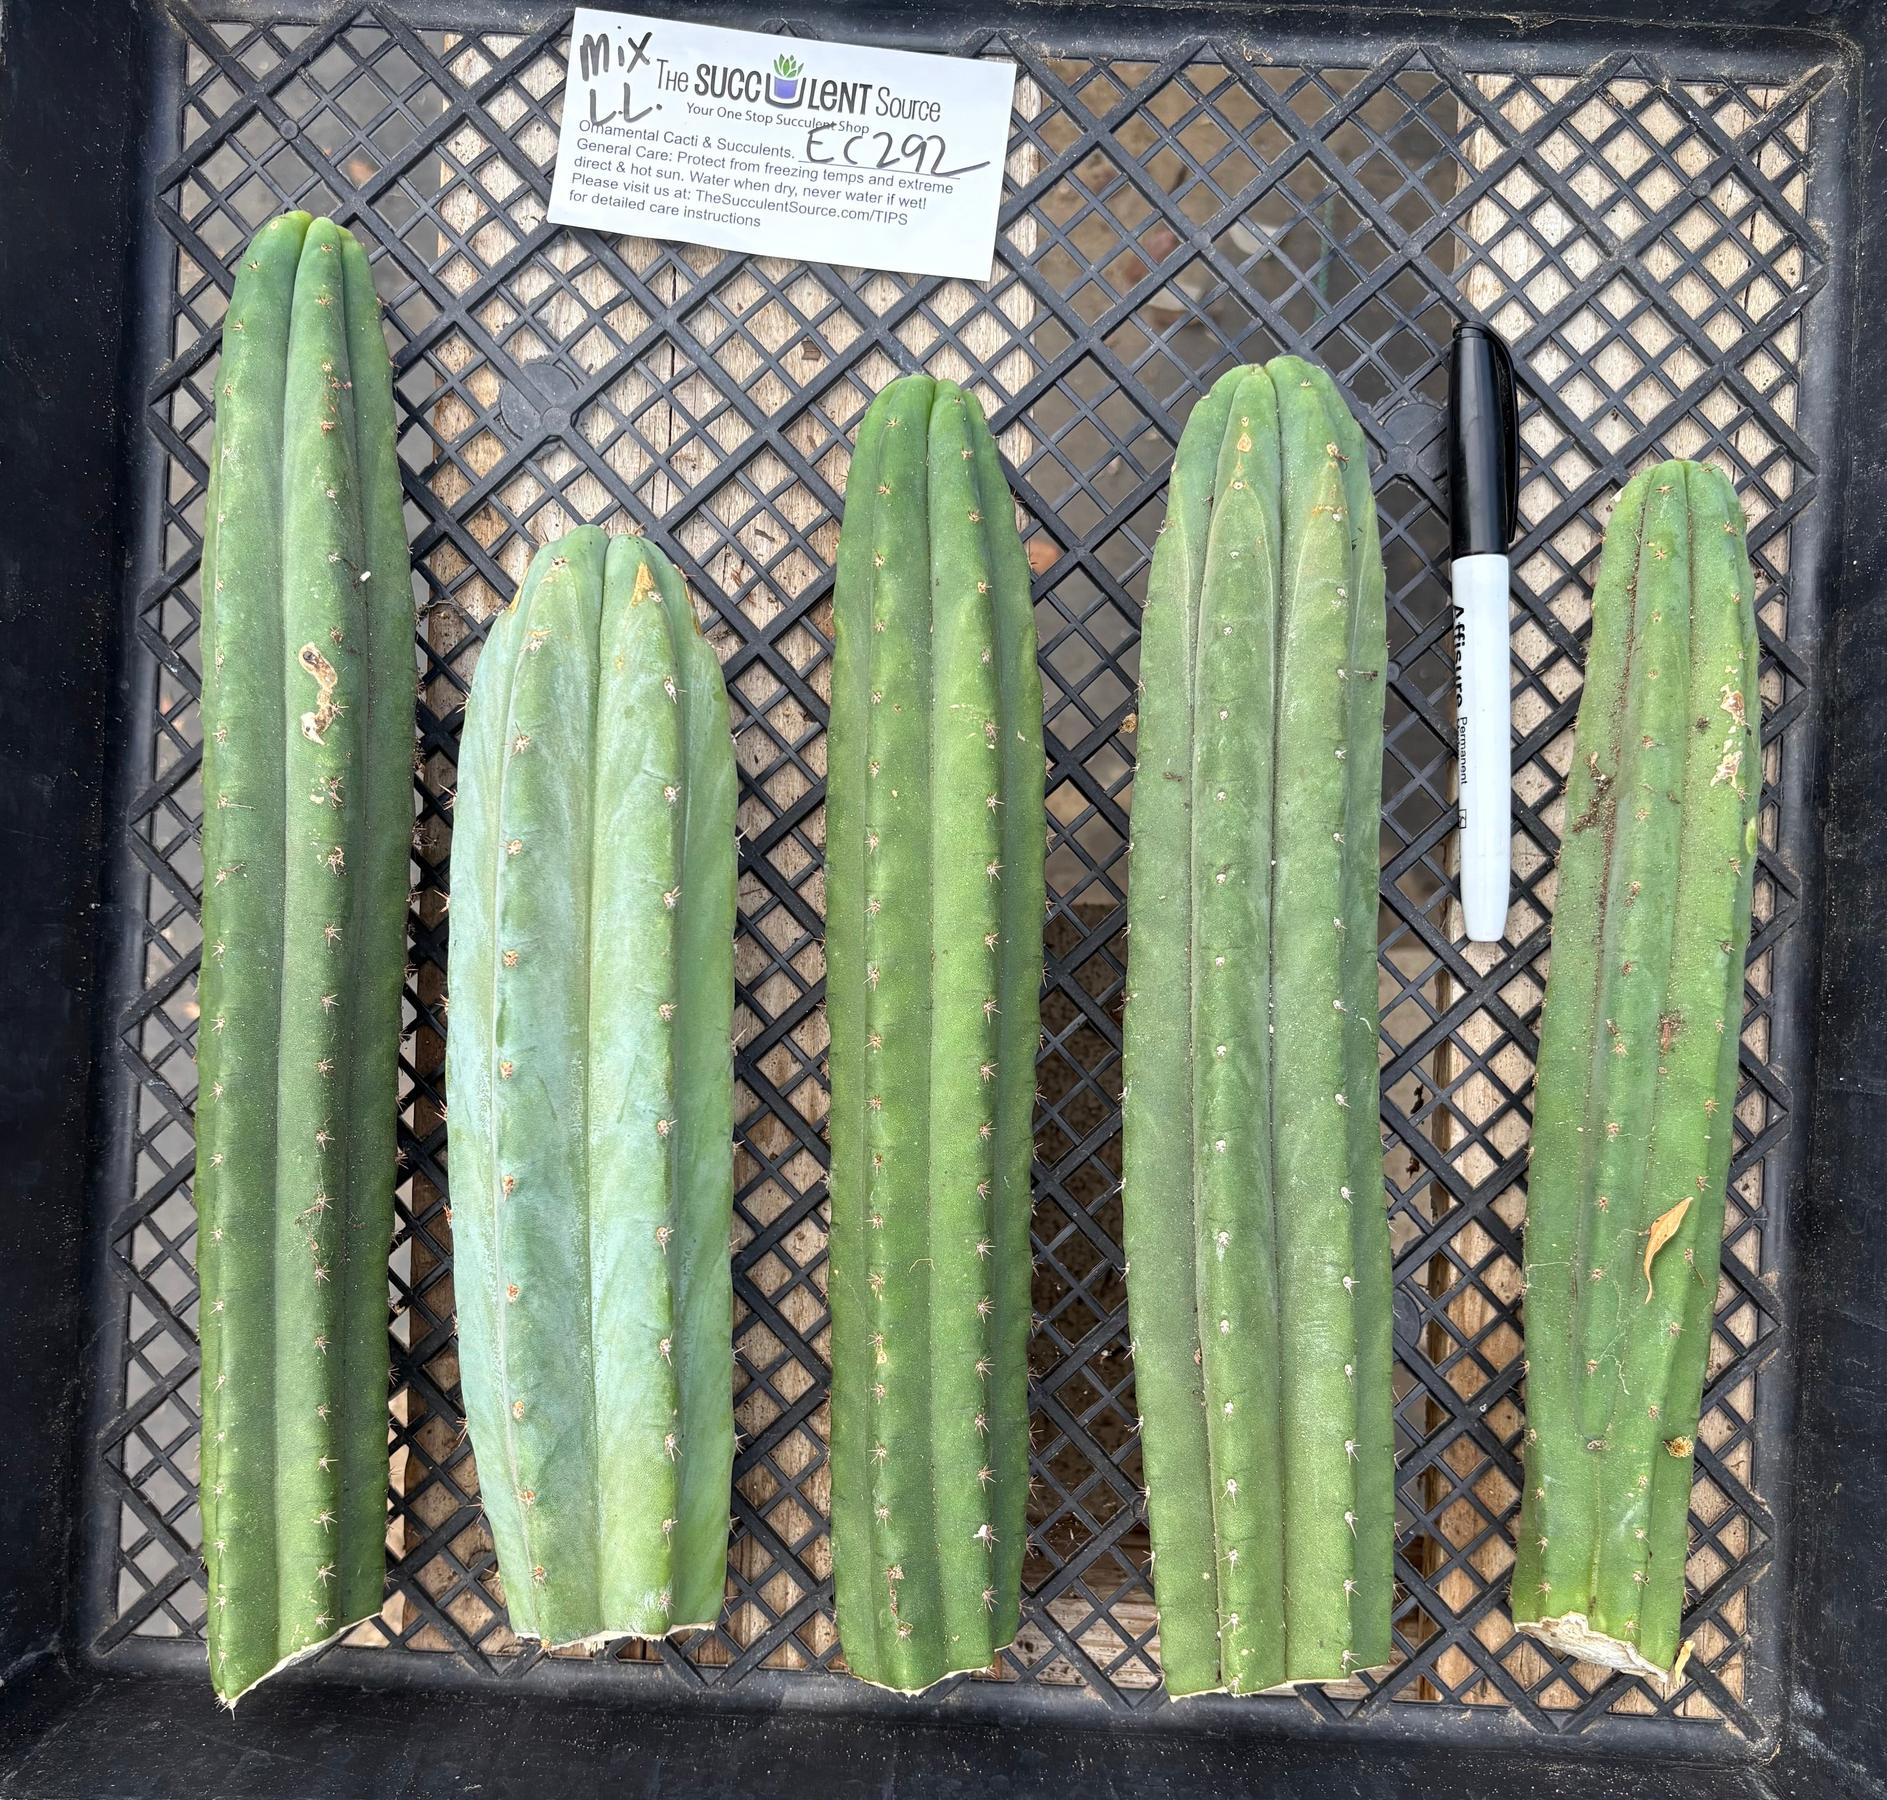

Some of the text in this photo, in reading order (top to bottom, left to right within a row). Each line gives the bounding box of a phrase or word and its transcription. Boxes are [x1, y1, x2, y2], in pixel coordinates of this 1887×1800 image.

[686, 102, 870, 136] Your One Stop Succulent Shop
[875, 86, 941, 123] Source
[576, 137, 954, 194] General Care: Protect from freezing temps and extreme
[579, 119, 795, 159] Ornamental Cacti & Succulents.
[806, 123, 991, 177] EC292
[569, 189, 761, 227] for detailed care instructions
[571, 172, 909, 226] Please visit us at: TheSucculentSource.com/TIPS
[573, 156, 927, 210] direct & hot sun. Water when dry, never water if wet!
[1459, 716, 1468, 785] Permanent
